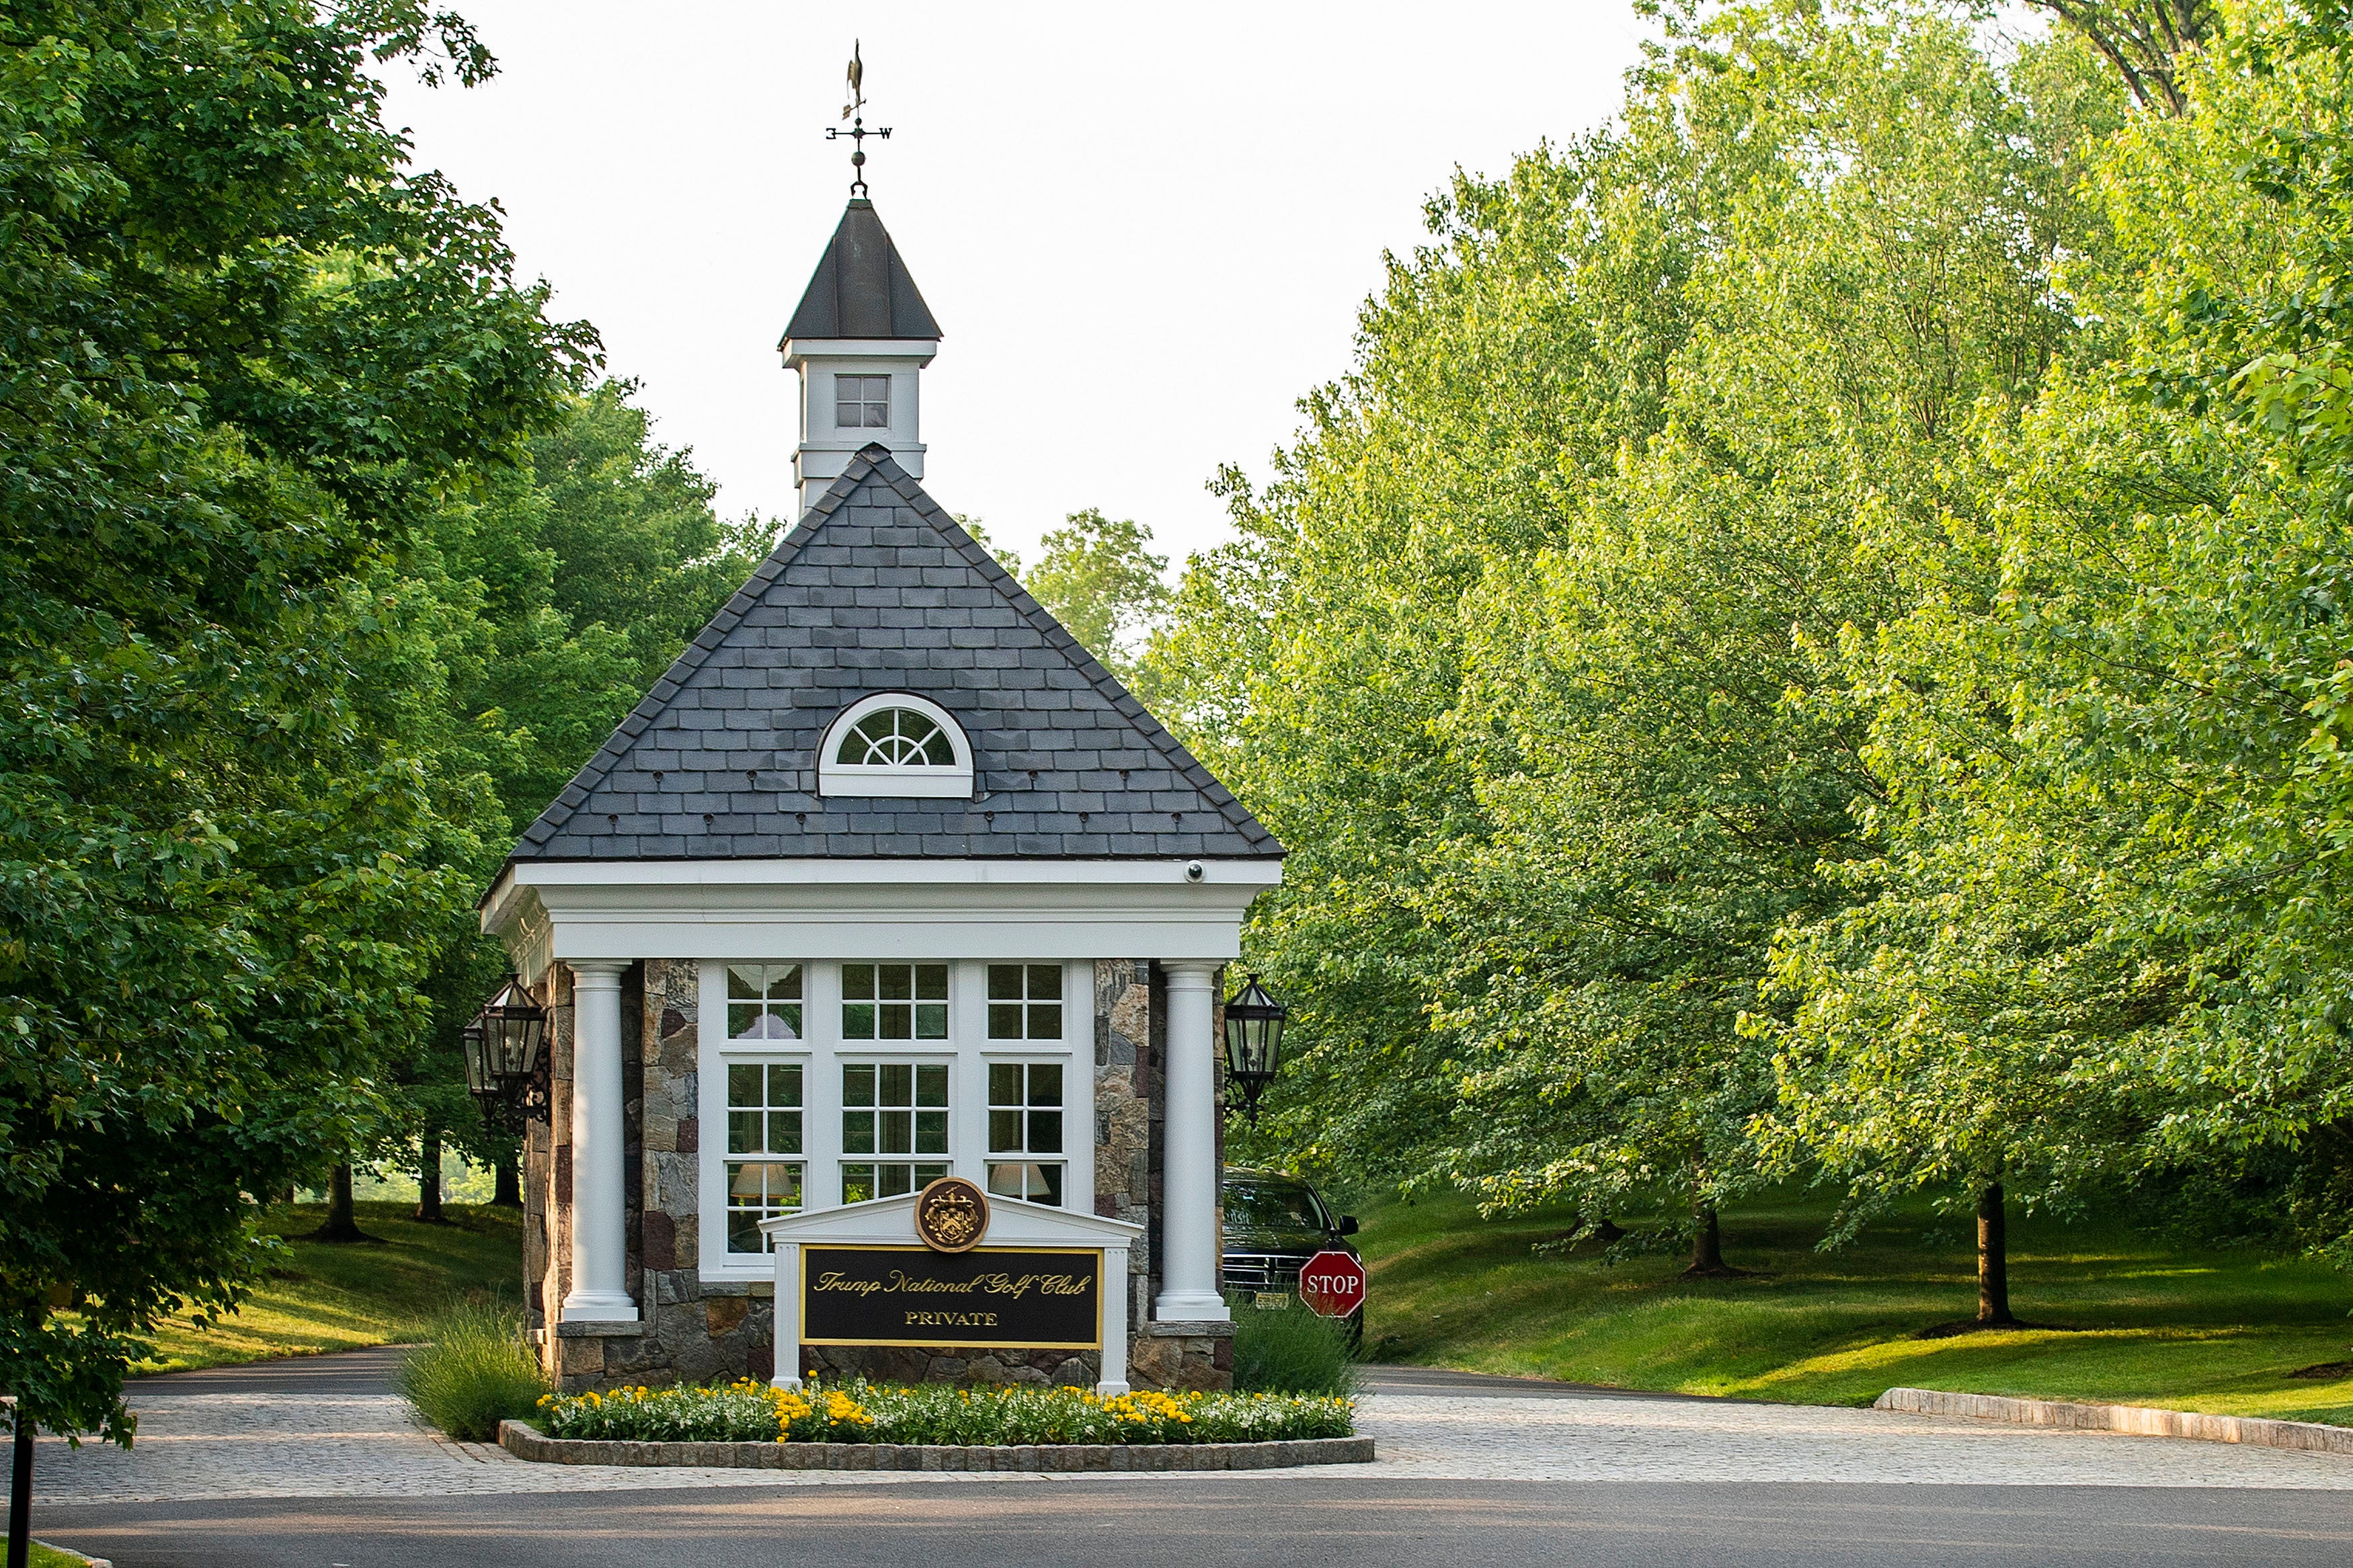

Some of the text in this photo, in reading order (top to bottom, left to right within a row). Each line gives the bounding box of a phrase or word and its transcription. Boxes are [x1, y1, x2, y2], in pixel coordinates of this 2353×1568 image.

[813, 1270, 1092, 1299] Trump National Golf Club
[1307, 1275, 1359, 1294] STOP
[905, 1311, 998, 1326] PRIVATE
